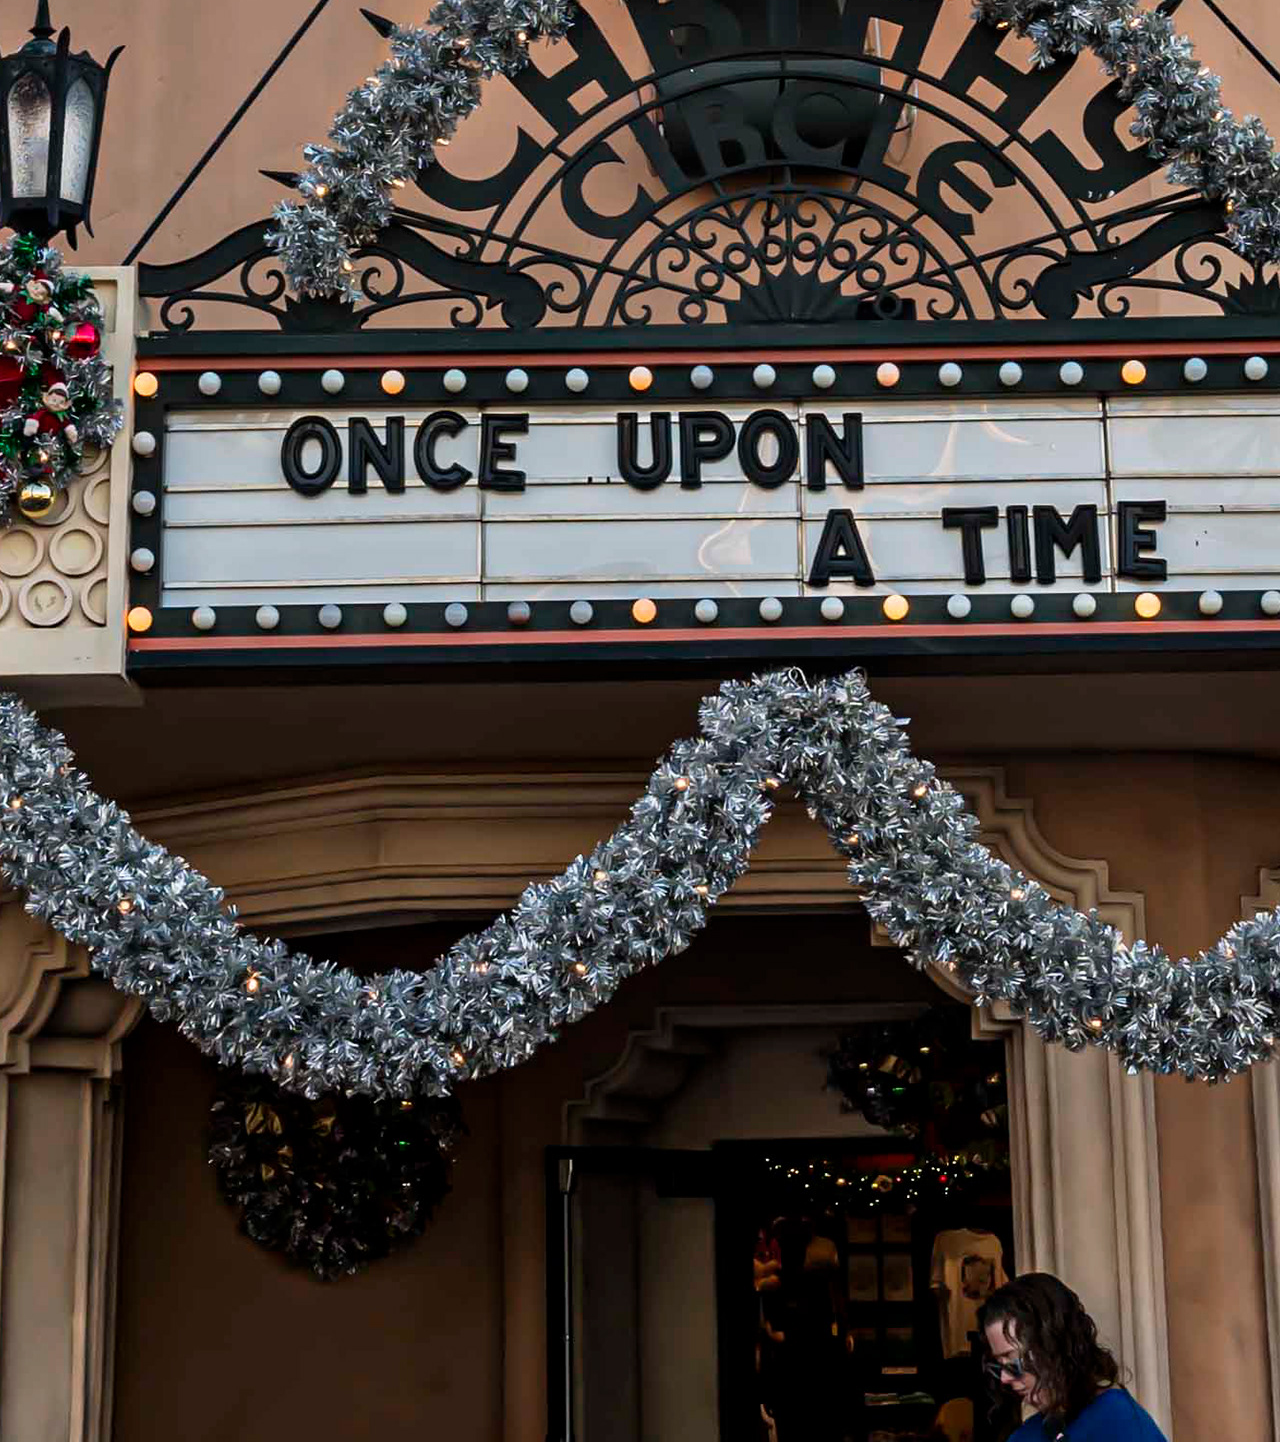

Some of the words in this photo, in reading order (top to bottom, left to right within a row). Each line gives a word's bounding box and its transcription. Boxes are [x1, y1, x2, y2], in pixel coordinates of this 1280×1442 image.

[560, 87, 1017, 241] CIRCLE
[281, 410, 528, 497] ONCE
[618, 408, 866, 492] UPON
[808, 507, 877, 589] A
[942, 499, 1168, 585] TIME
